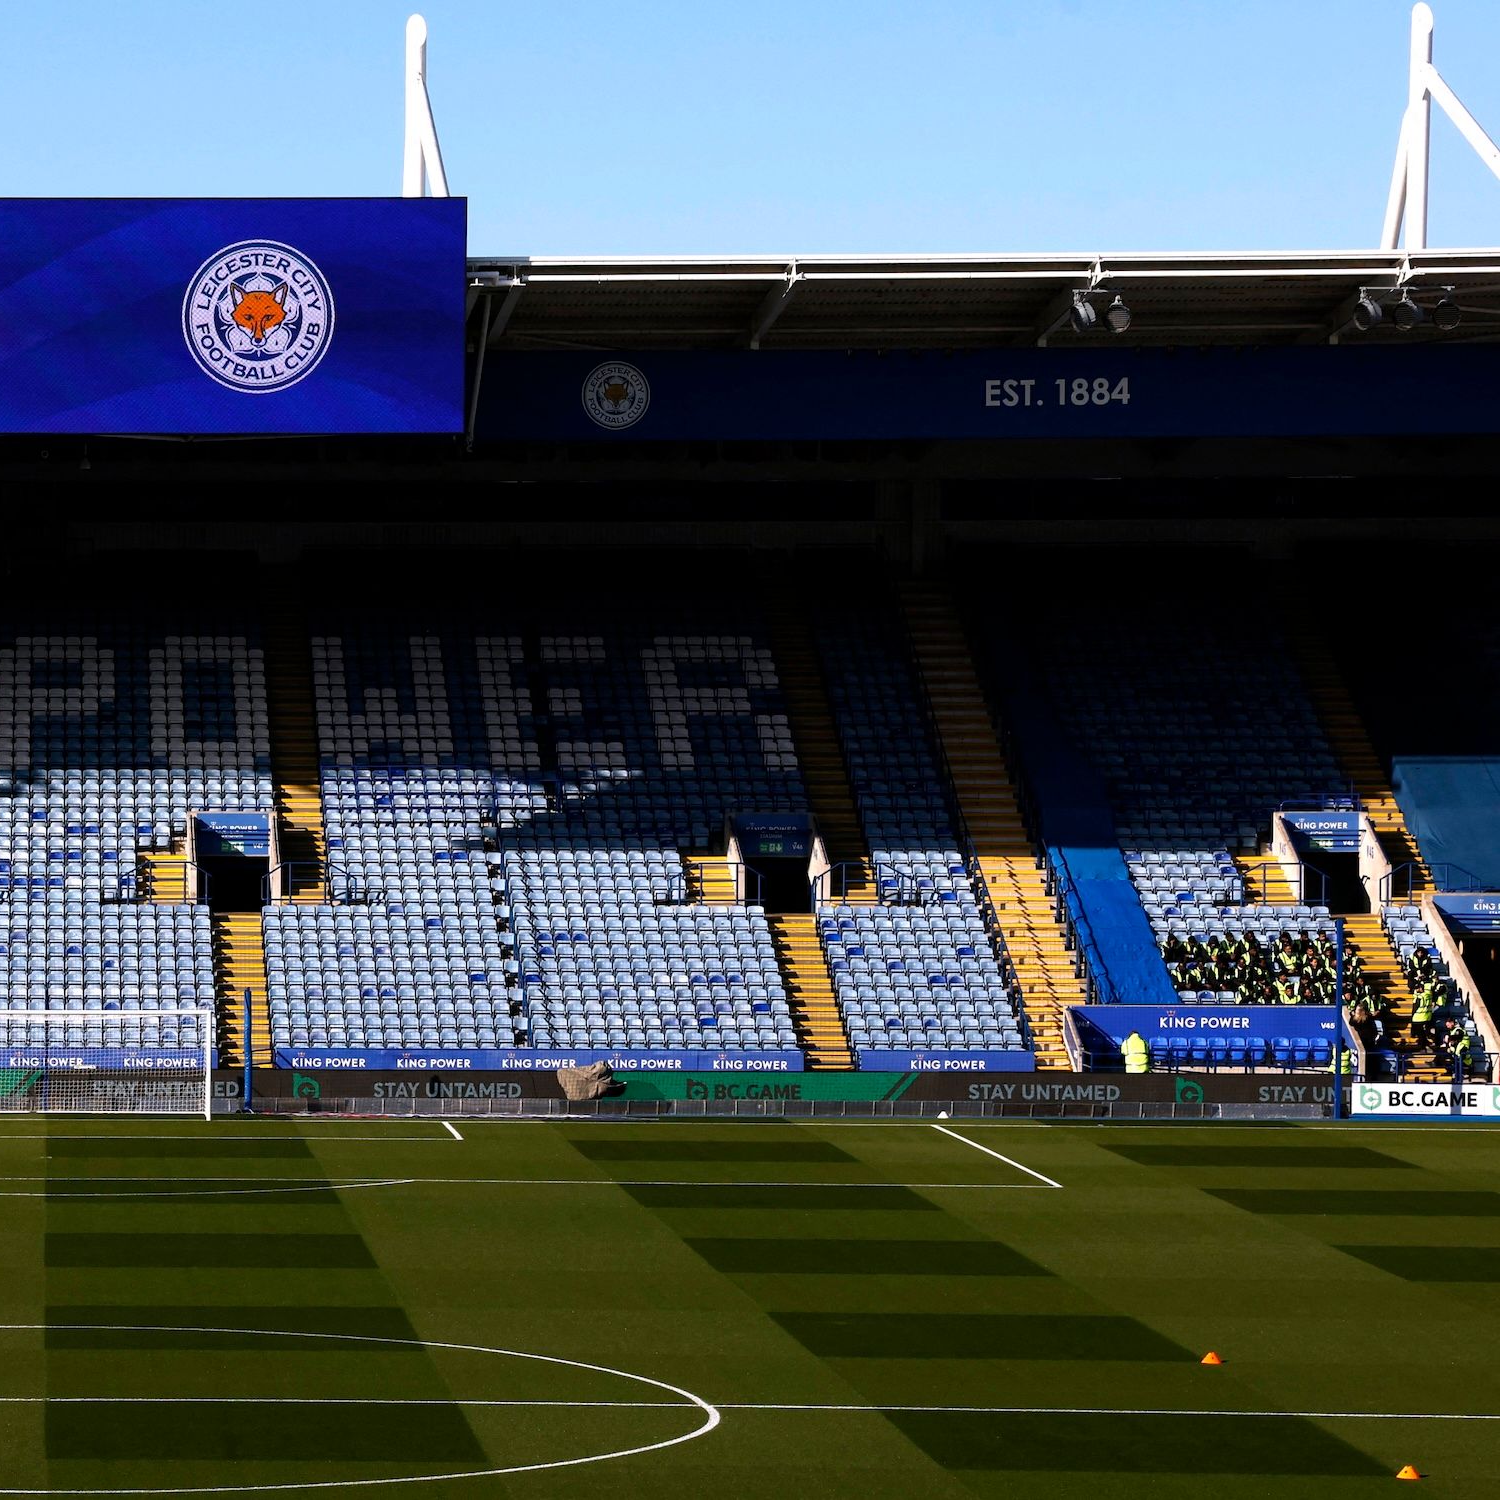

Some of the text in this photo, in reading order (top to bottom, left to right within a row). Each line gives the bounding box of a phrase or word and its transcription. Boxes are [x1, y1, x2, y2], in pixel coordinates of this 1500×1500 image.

[197, 253, 321, 311] LEICESTER CITY
[197, 322, 320, 380] FOOTBALL CLUB
[589, 368, 644, 393] LEICESTER CITY
[985, 376, 1131, 407] EST. 1884
[588, 397, 644, 424] FOOTBALL CLUB
[1474, 903, 1496, 911] KING
[1160, 1018, 1250, 1028] KING POWER
[10, 1057, 39, 1067] KING
[124, 1057, 197, 1067] KING POWER
[292, 1058, 365, 1068] KING POWER
[397, 1058, 470, 1068] KING POWER
[502, 1058, 576, 1068] KING POWER
[608, 1059, 682, 1069] KING POWER
[713, 1059, 787, 1069] KING POWER
[910, 1059, 985, 1069] KING POWER
[373, 1082, 521, 1098] STAY UNTAMED
[714, 1084, 800, 1100] BC.GAME
[968, 1084, 1120, 1102] STAY UNTAMED
[1258, 1086, 1306, 1102] STAY
[1388, 1091, 1478, 1108] BC.GAME
